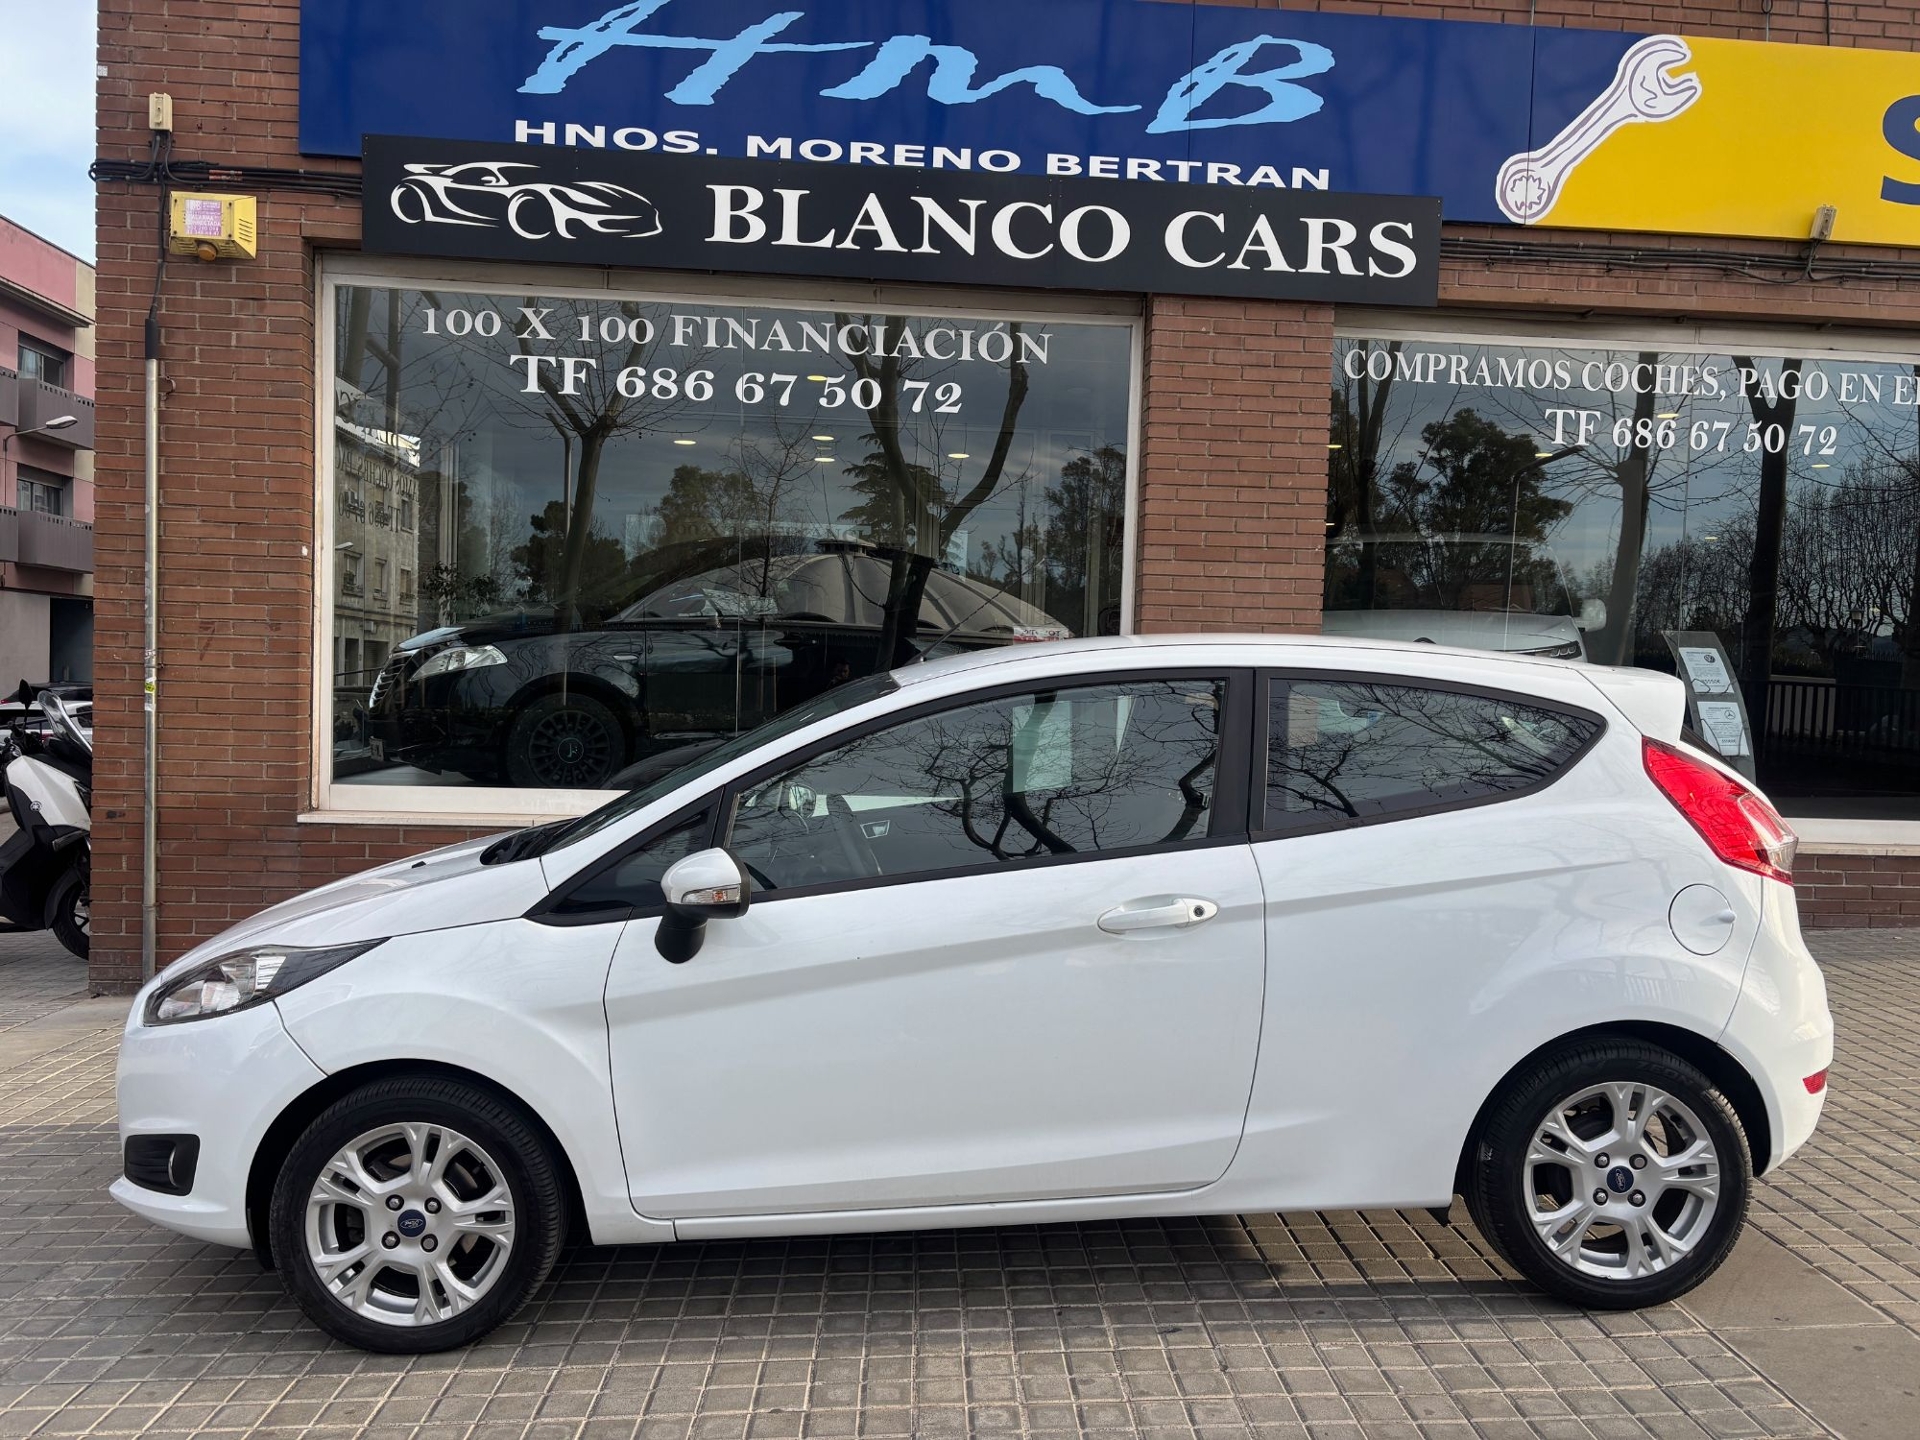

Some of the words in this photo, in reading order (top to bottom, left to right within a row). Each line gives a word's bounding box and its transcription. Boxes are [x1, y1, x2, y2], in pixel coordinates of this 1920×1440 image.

[515, 119, 718, 155] HNOS.
[746, 135, 1021, 172] MORENO
[1046, 153, 1330, 191] BERTRAN
[705, 184, 1131, 263] BLANCO
[1165, 210, 1417, 278] CARS
[422, 307, 502, 337] 100
[516, 307, 557, 340] X
[577, 315, 655, 345] 100
[669, 314, 1053, 365] FINANCIACIÓN
[509, 354, 597, 396] TF
[616, 366, 715, 402] 686
[735, 371, 798, 407] 67
[818, 373, 882, 410] 50
[902, 379, 962, 414] 72
[1344, 348, 1572, 389] COMPRAMOS
[1580, 361, 1727, 403] COCHES,
[1737, 367, 1830, 402] PAGO
[1838, 372, 1885, 404] EN
[1545, 408, 1601, 447] TF
[1612, 416, 1676, 449] 686
[1689, 420, 1731, 452] 67
[1742, 421, 1785, 454] 50
[1797, 424, 1838, 456] 72
